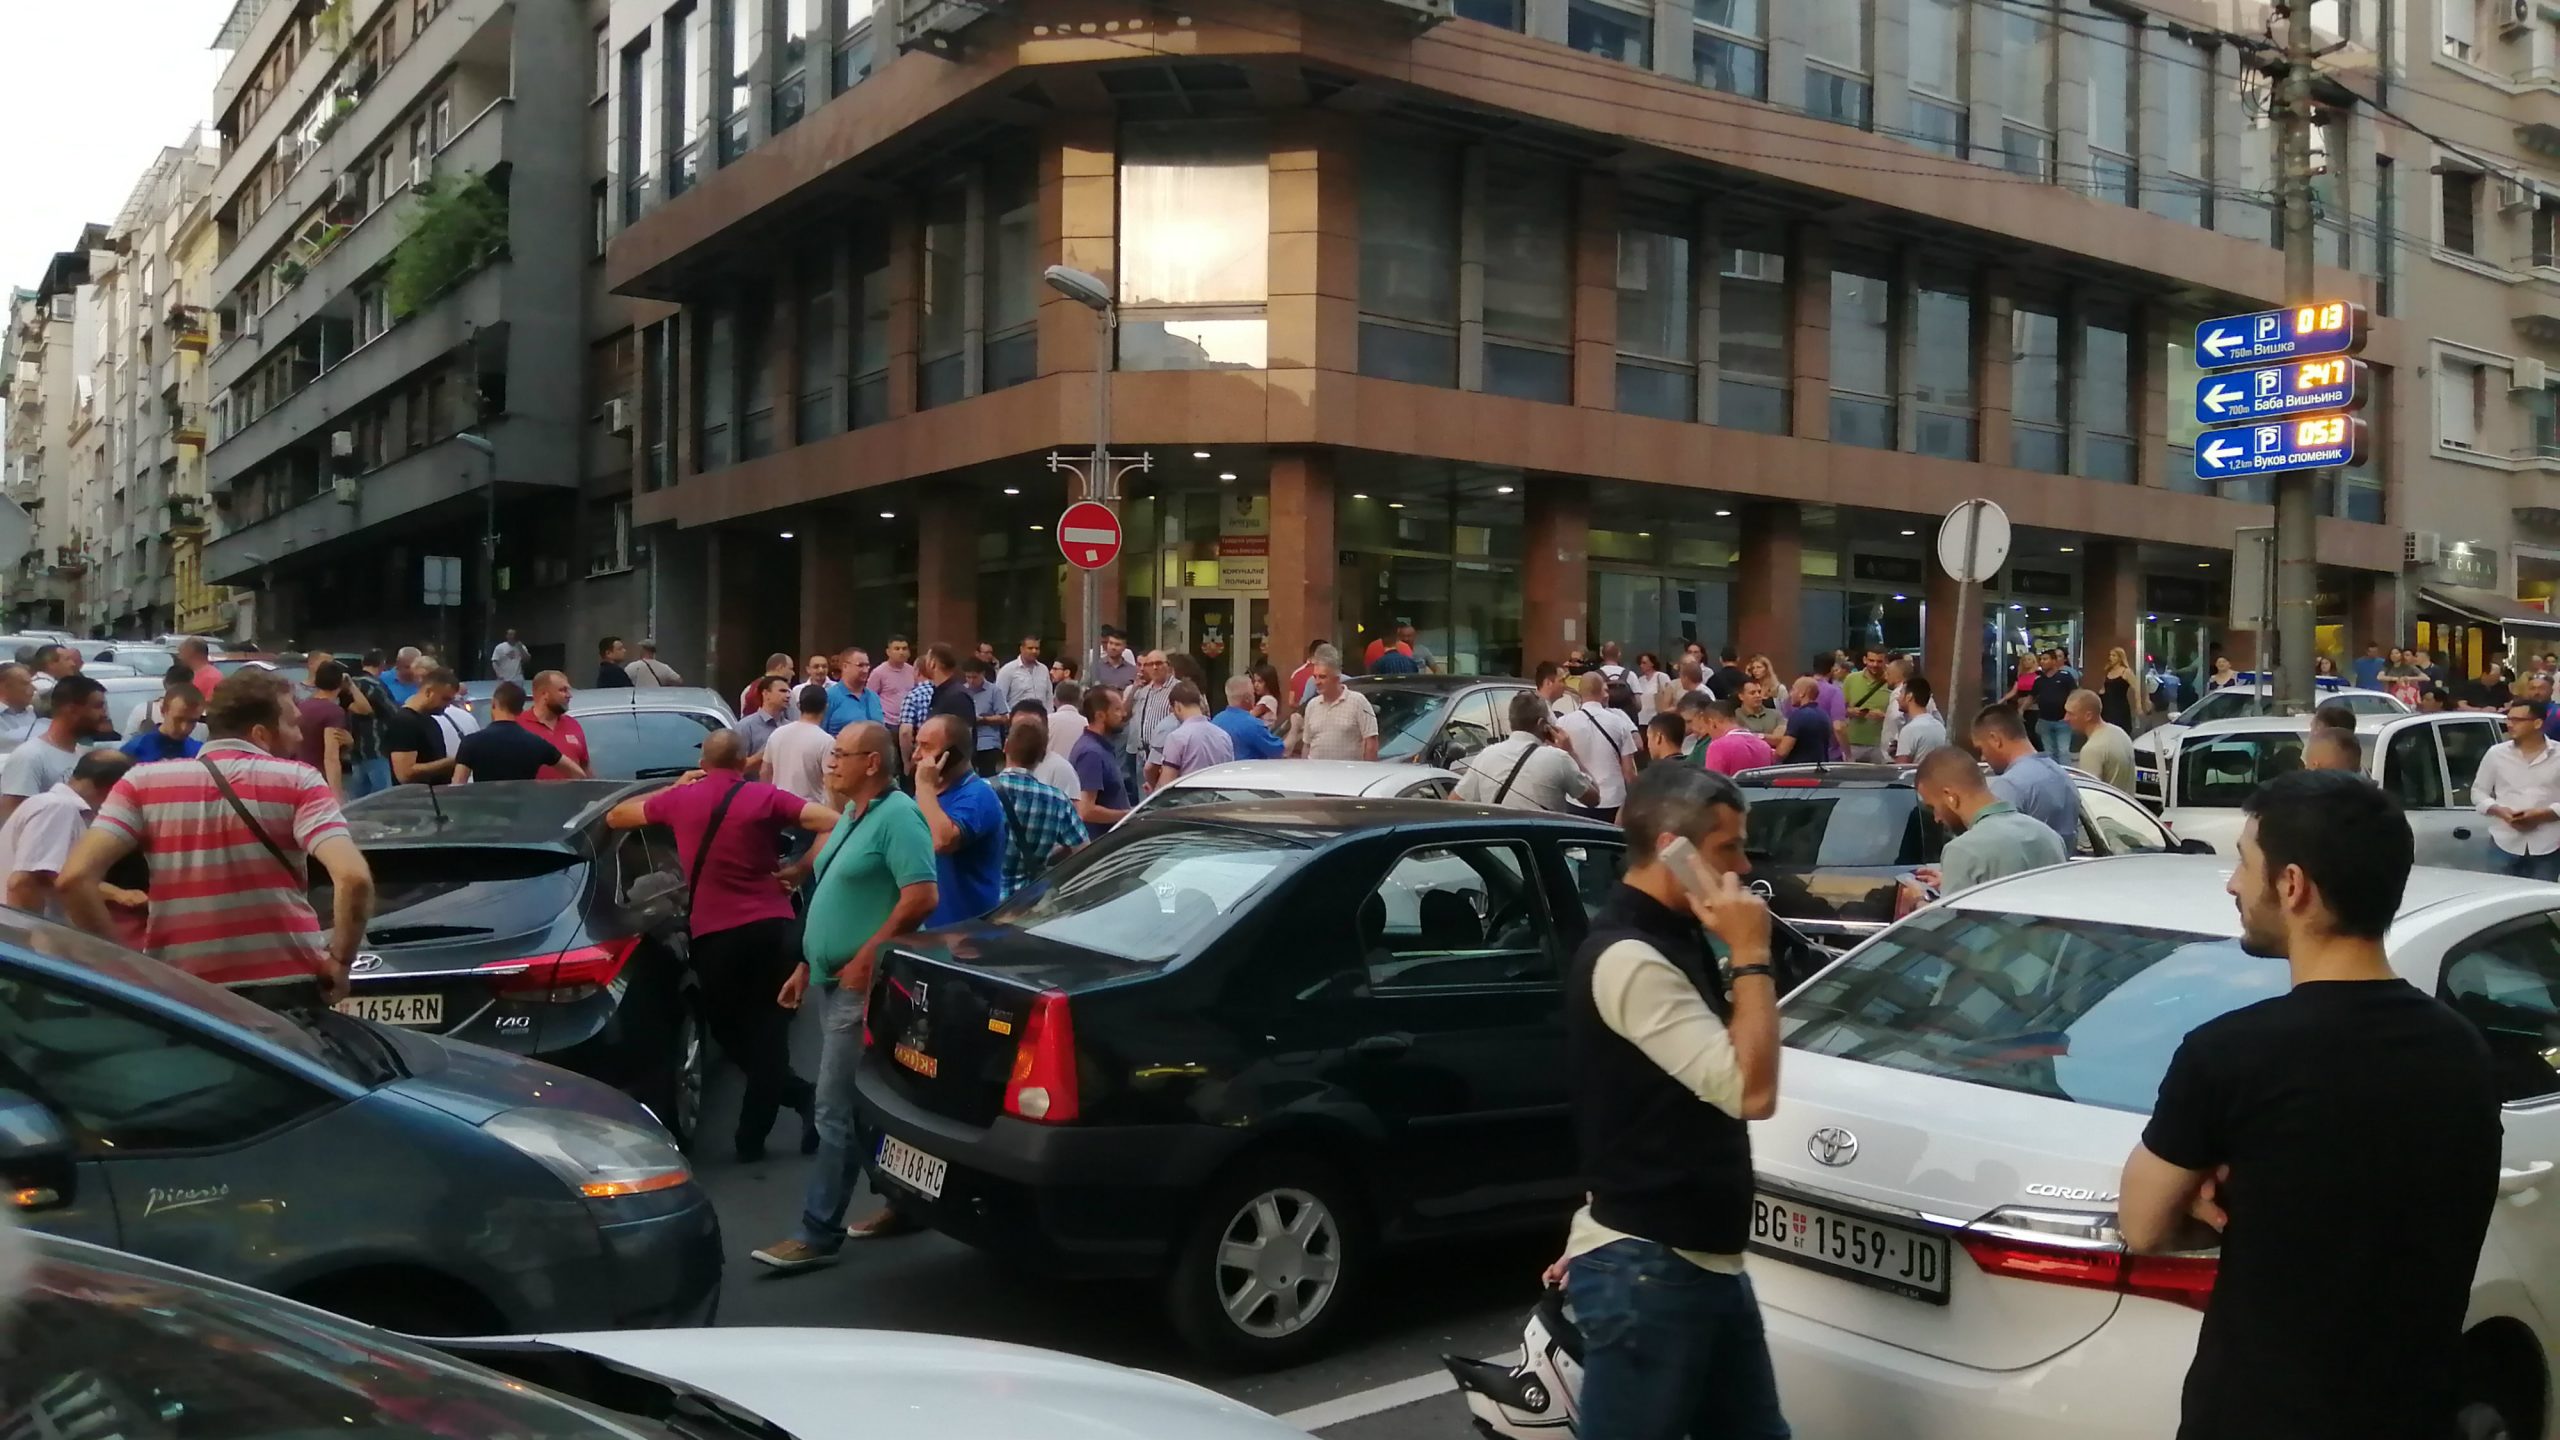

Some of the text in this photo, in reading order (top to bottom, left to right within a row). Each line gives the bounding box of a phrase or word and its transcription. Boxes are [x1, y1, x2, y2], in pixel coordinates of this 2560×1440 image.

[2254, 342, 2295, 356] Вишка
[2299, 360, 2345, 388] 247
[2254, 391, 2343, 411] Баба Вишњина
[2299, 418, 2344, 445] 053
[2254, 447, 2342, 468] Вуков споменик
[881, 1138, 896, 1168] BG
[1754, 1200, 1787, 1242] BG
